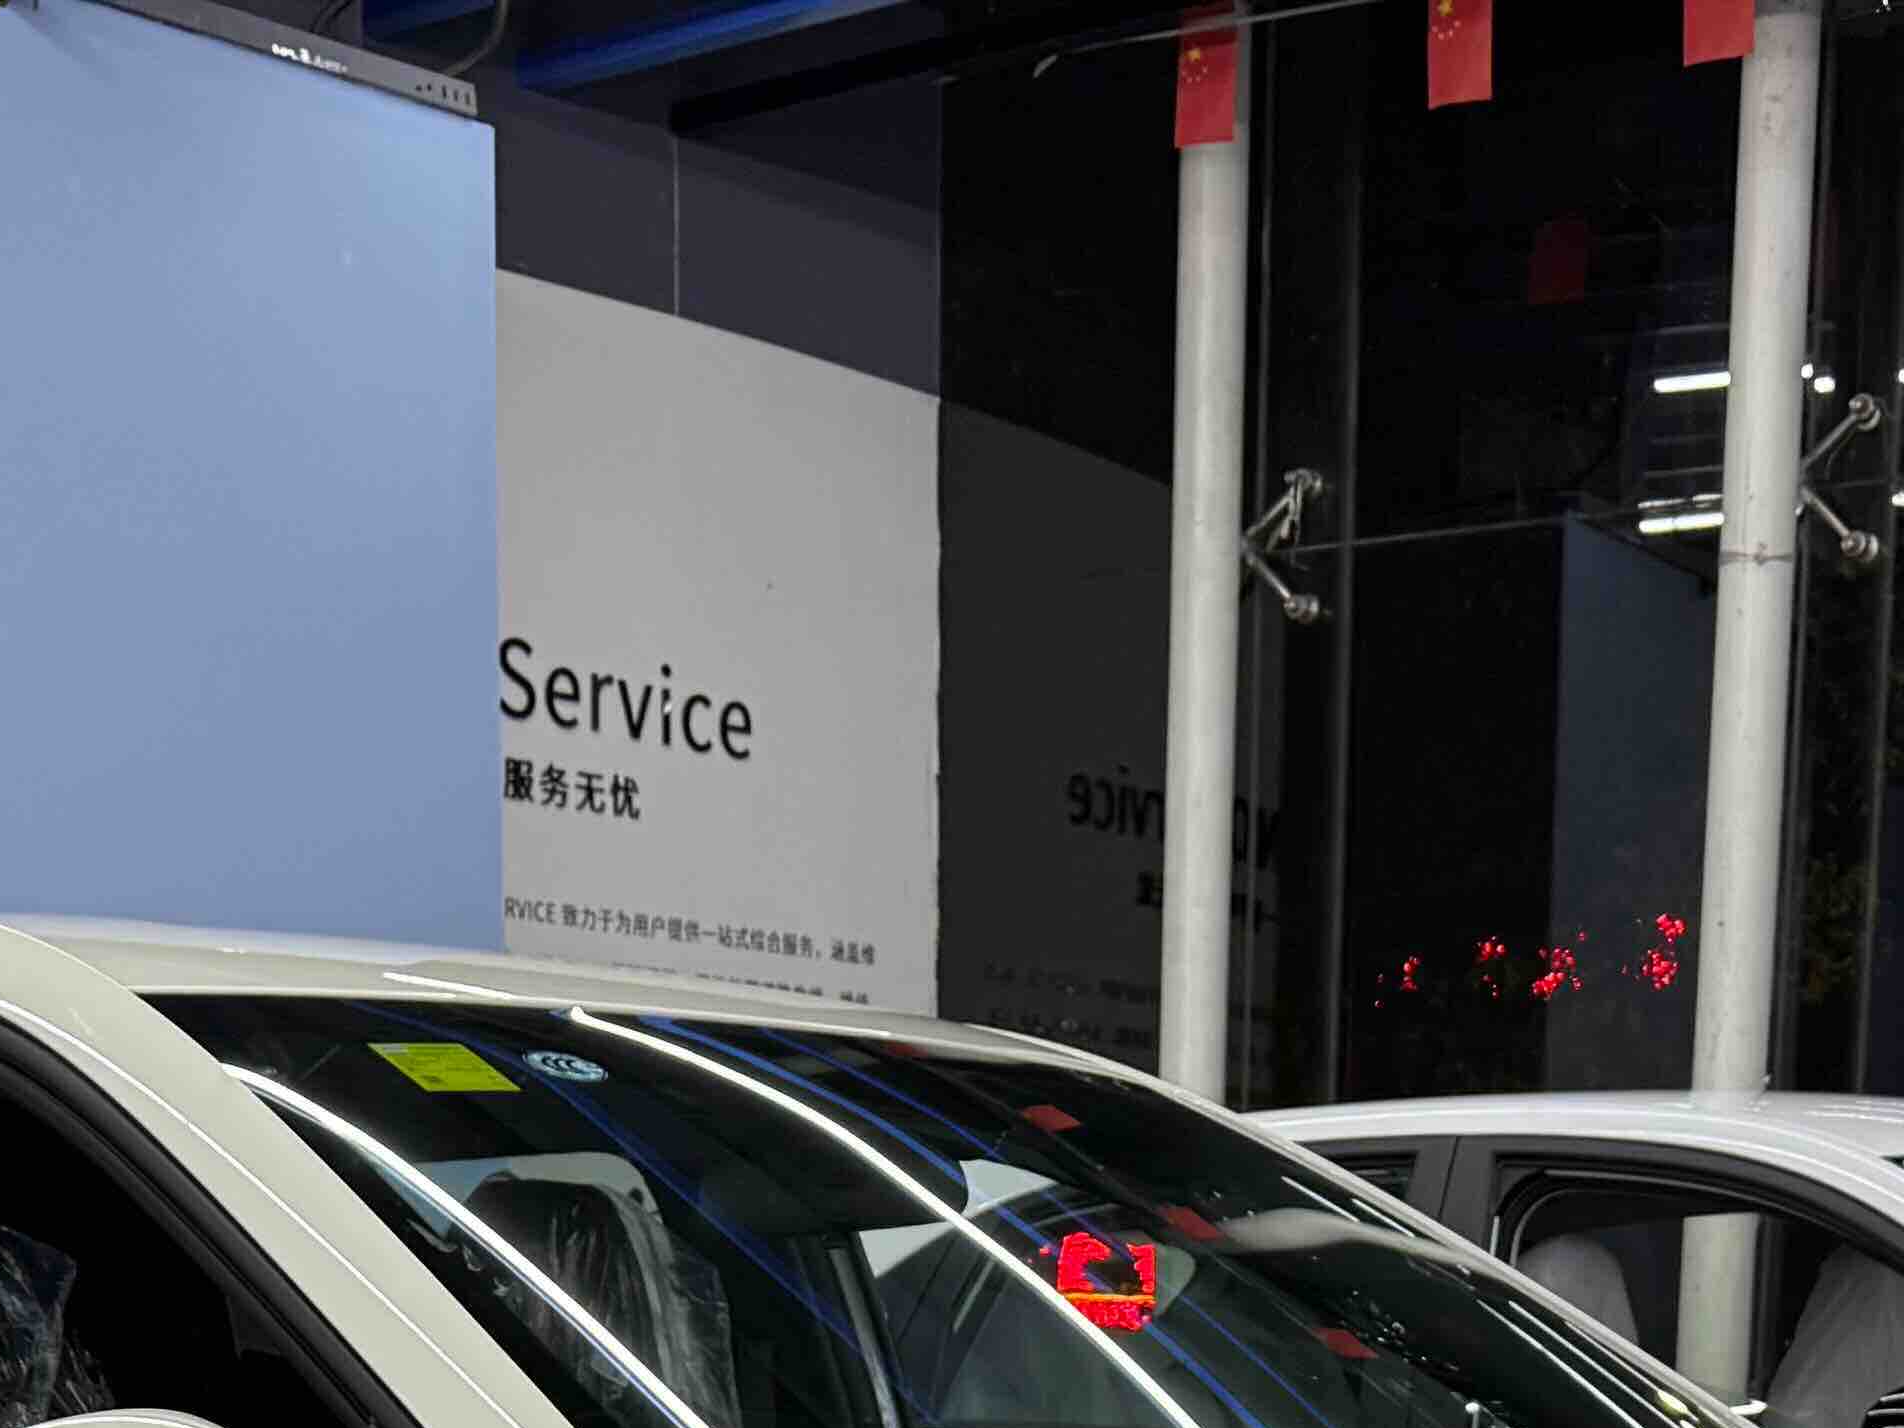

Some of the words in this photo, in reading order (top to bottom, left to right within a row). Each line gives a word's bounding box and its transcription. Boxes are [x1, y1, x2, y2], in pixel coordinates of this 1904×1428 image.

[499, 636, 752, 760] Service
[503, 756, 641, 820] 服务无忧
